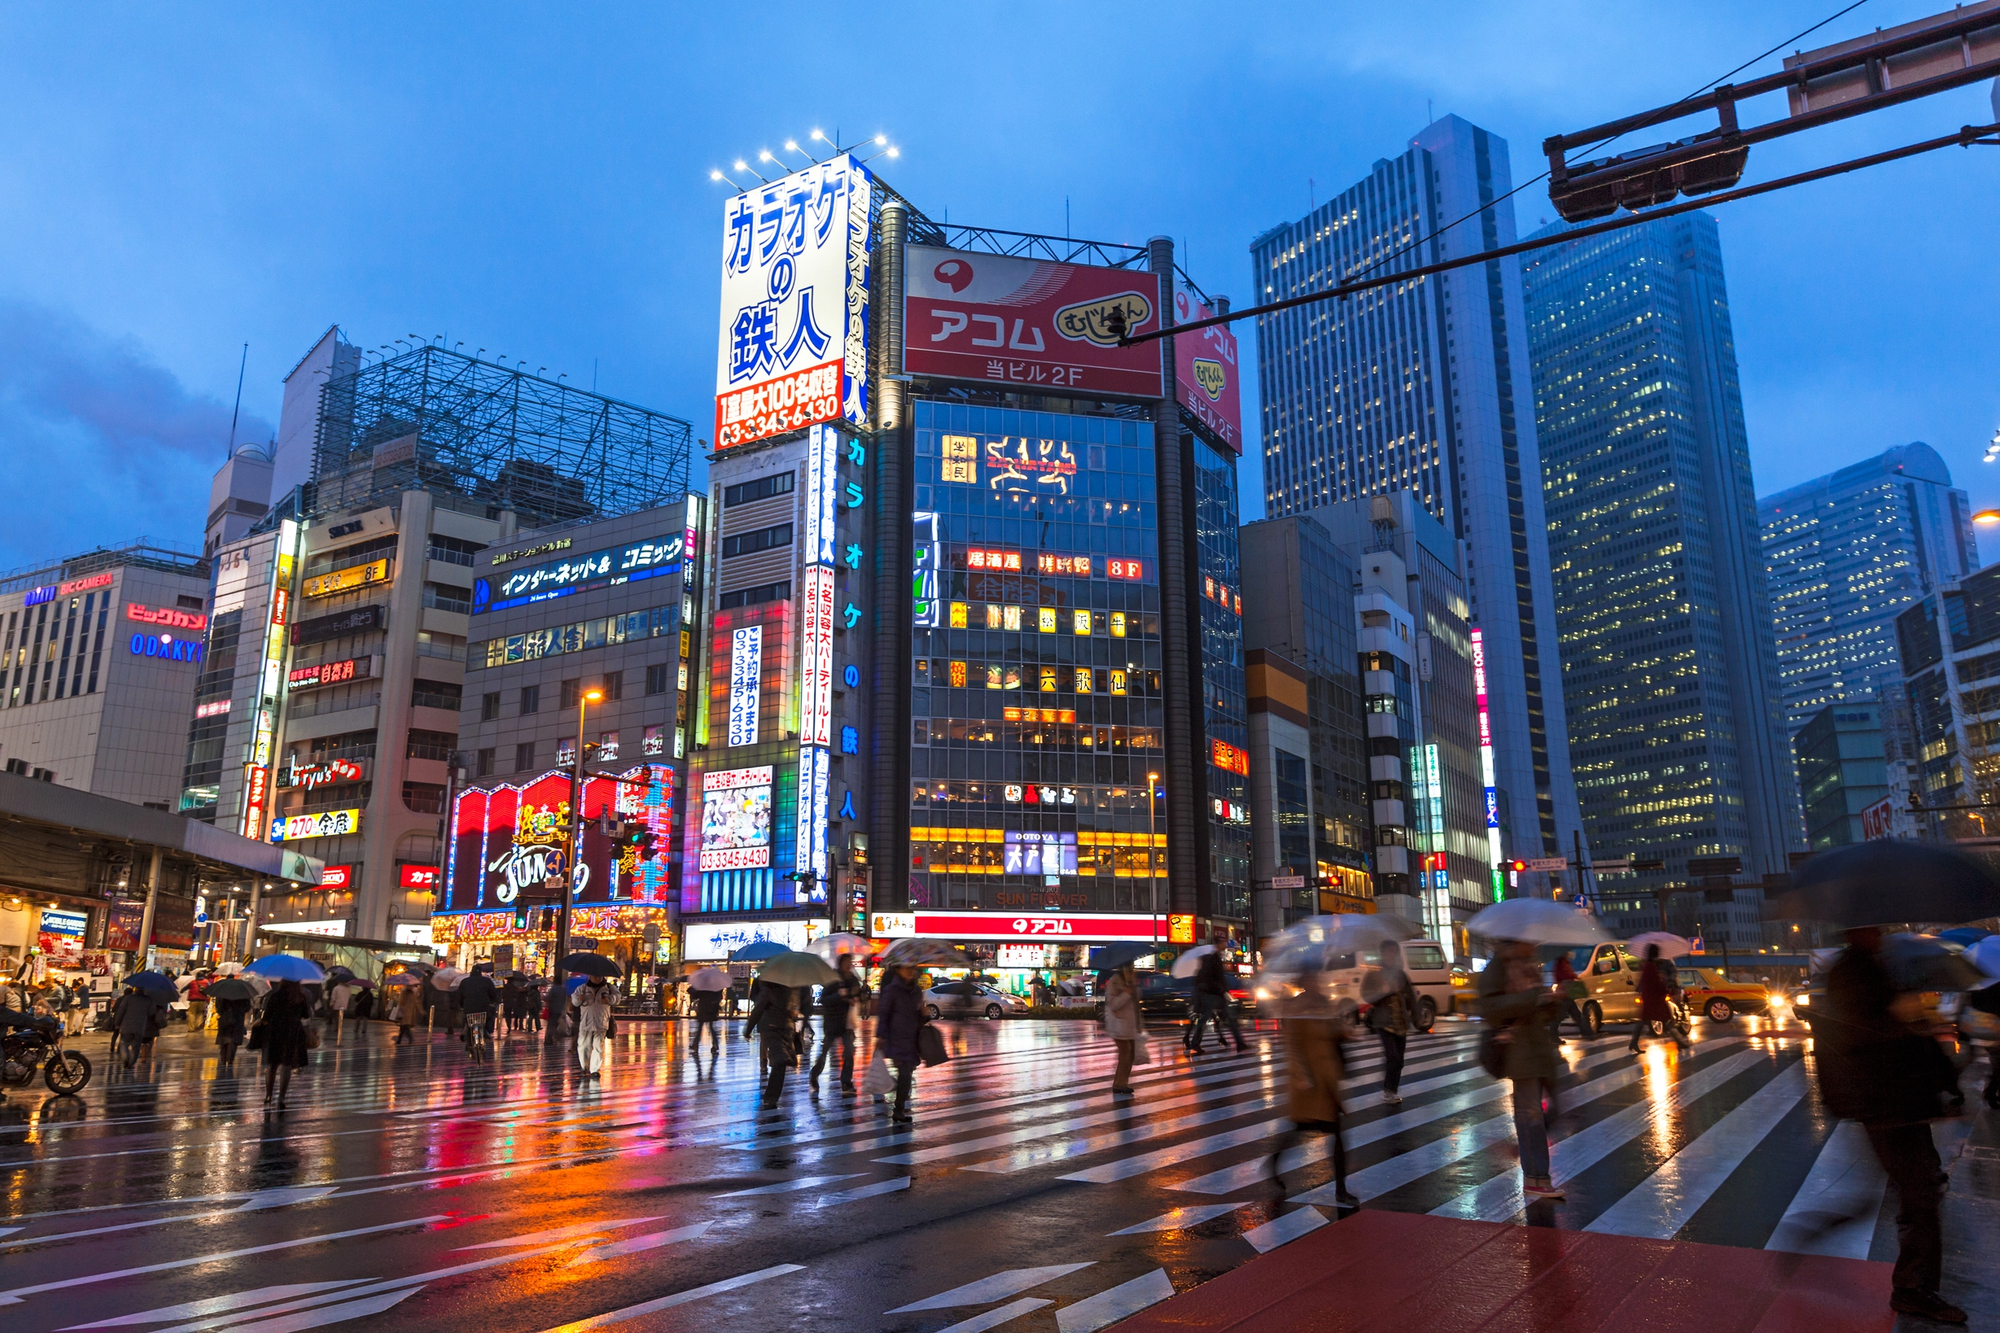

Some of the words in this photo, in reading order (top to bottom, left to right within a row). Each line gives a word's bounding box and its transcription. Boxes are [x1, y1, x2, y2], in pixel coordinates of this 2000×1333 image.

[725, 163, 847, 278] カラオケ
[766, 251, 796, 304] の
[843, 165, 870, 426] カラオケの鉄人
[729, 285, 831, 384] 鉄人
[931, 309, 1046, 352] アコム
[1064, 301, 1143, 340] むじんん
[721, 364, 838, 426] 1室最大100名収容
[1196, 364, 1223, 395] むじんくん
[719, 395, 838, 447] 03-3345-6430
[953, 441, 968, 479] 坐和民
[365, 566, 379, 581] 8F
[502, 556, 597, 596] インターネット
[597, 556, 611, 574] &
[621, 538, 683, 569] コミック
[968, 550, 1020, 570] 居酒屋
[1110, 560, 1139, 577] 8F
[60, 583, 76, 595] BIC
[75, 573, 113, 592] CAMERA
[321, 659, 354, 684] 自然洞
[802, 568, 817, 742] 100名収容大パーティールーム
[816, 568, 833, 743] 100名収容大パーティールーム
[730, 629, 747, 746] 03-3345-6430
[745, 627, 759, 744] ご予約承ります
[951, 662, 966, 688] 焼肉
[1041, 670, 1127, 692] 六歌仙
[251, 769, 265, 803] カラオケ
[272, 824, 285, 838] 3F
[291, 818, 313, 838] 270
[319, 812, 350, 837] 金の蔵
[1015, 833, 1054, 841] OOTOYA
[488, 845, 590, 903] JUMO
[701, 848, 768, 869] 03-3345-6430
[411, 871, 440, 883] カラ
[997, 893, 1025, 905] SUN
[1030, 893, 1088, 906] FLOWER
[1031, 919, 1072, 933] アコム
